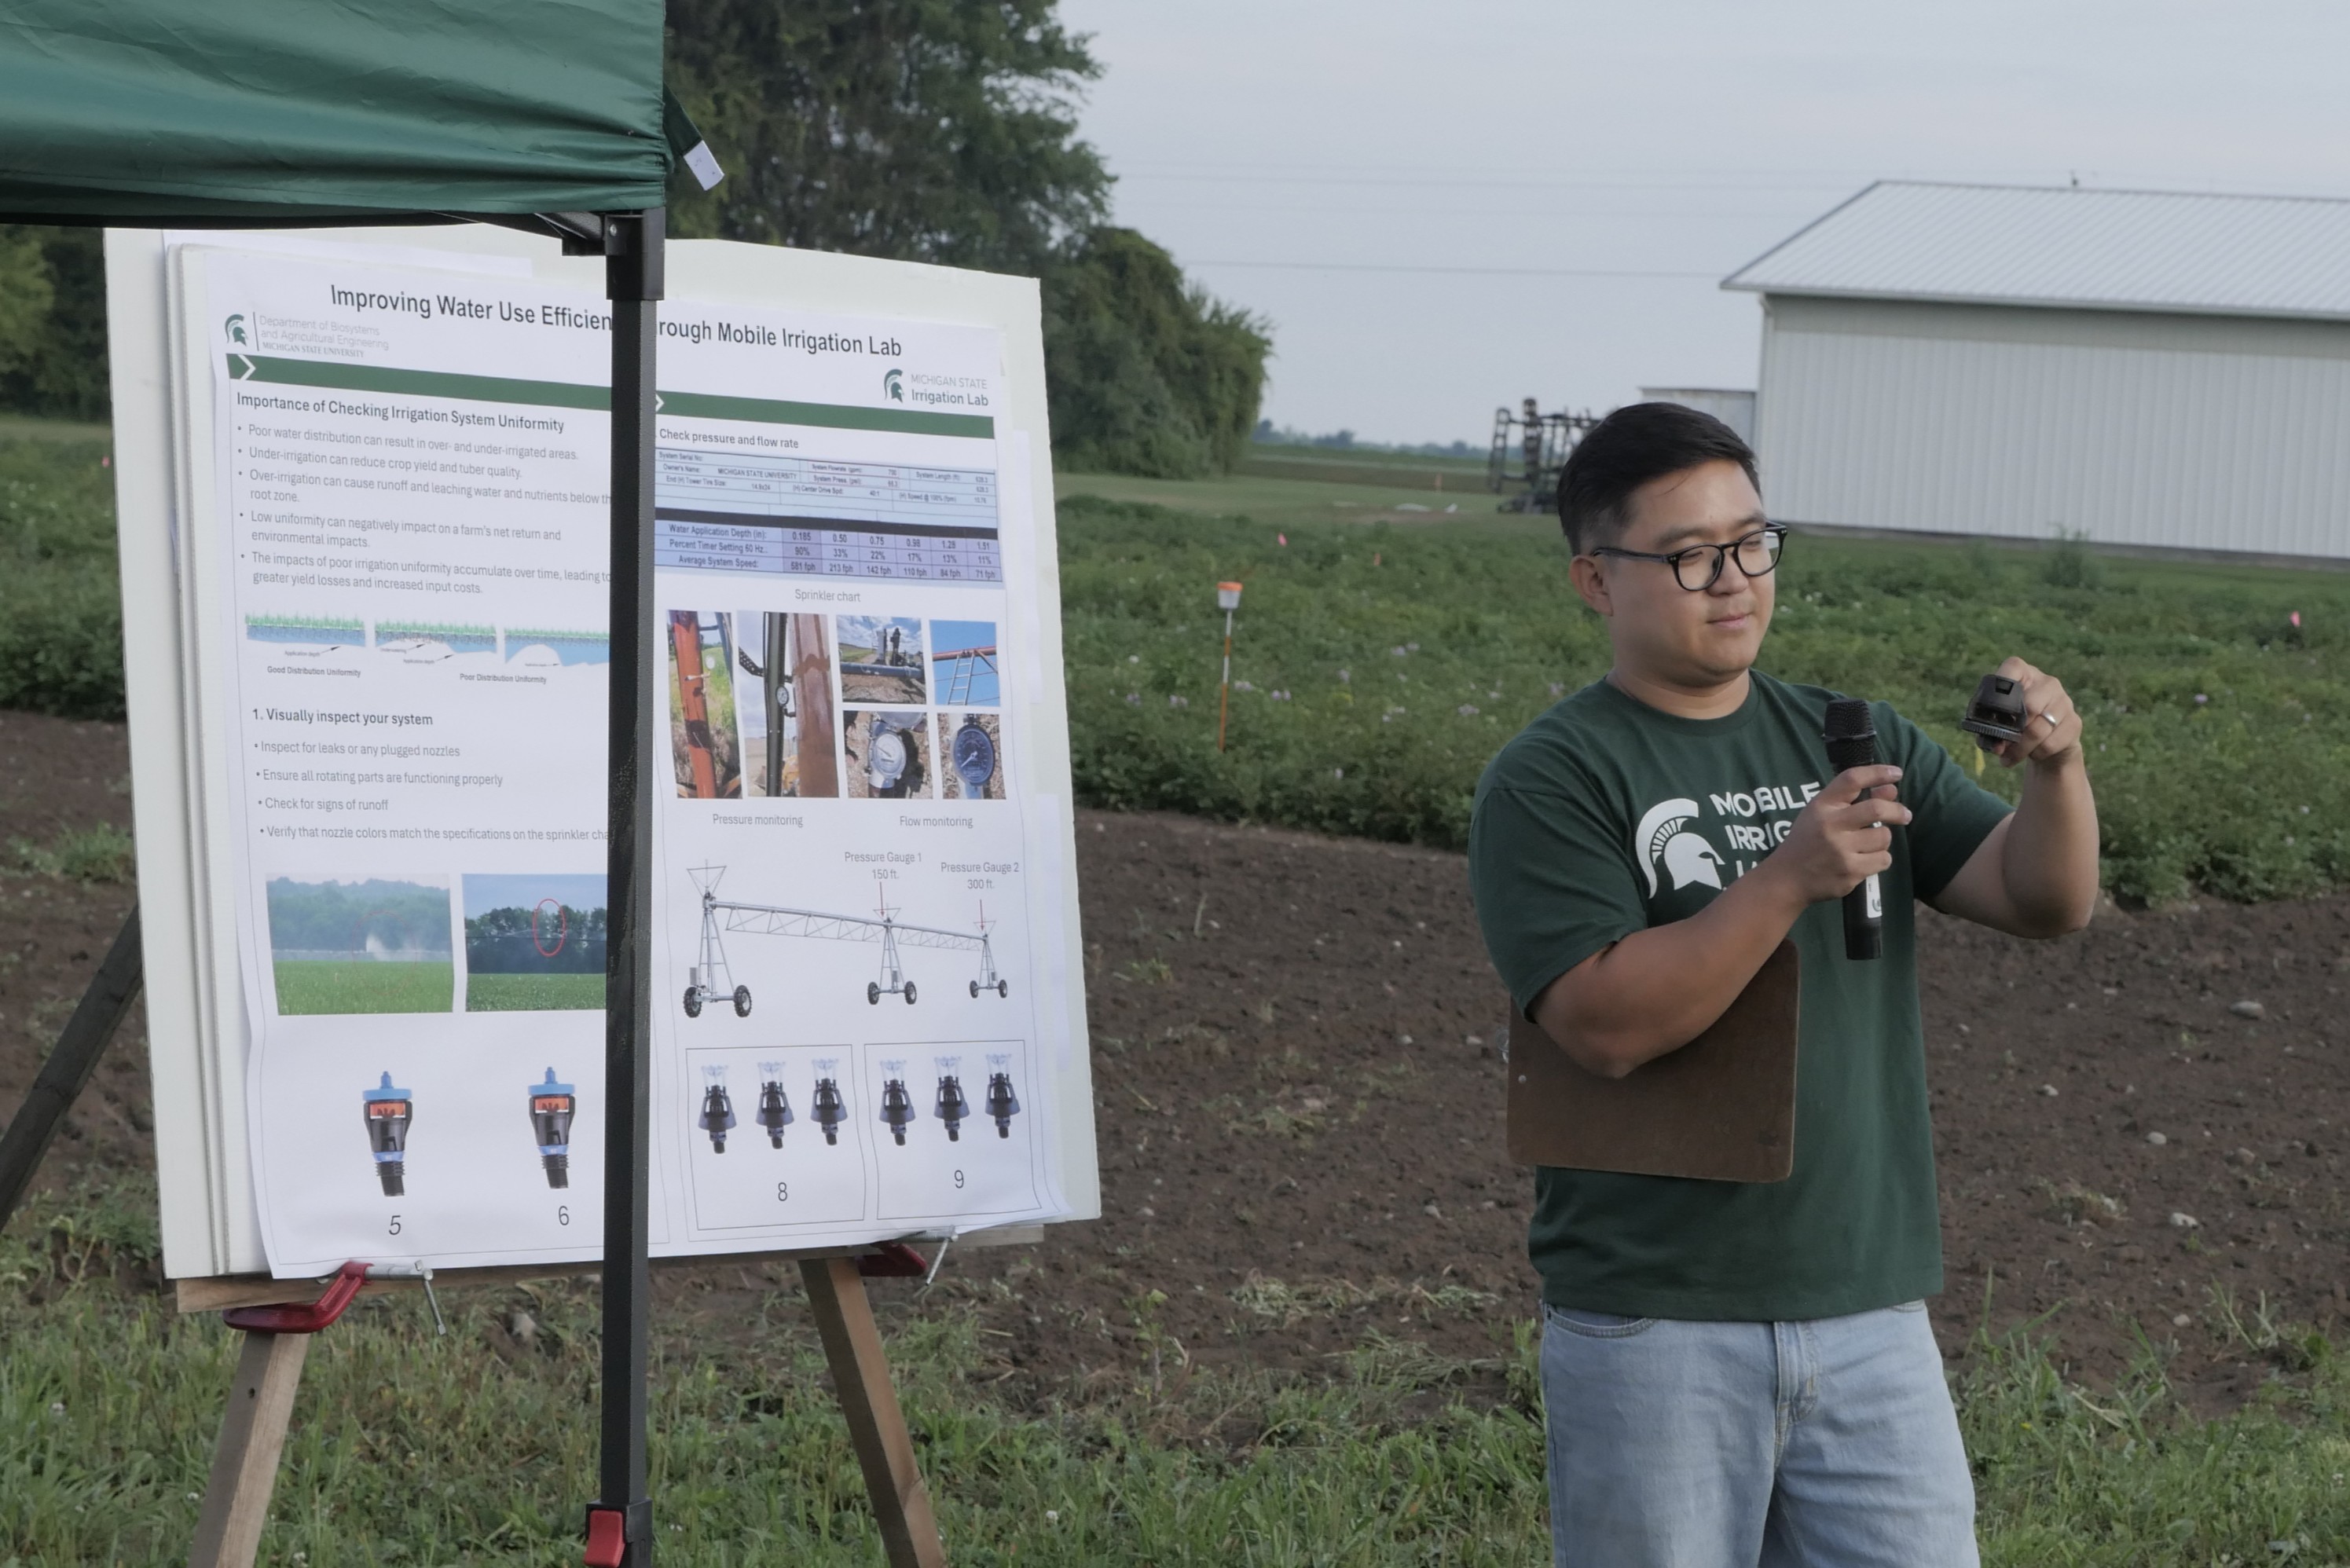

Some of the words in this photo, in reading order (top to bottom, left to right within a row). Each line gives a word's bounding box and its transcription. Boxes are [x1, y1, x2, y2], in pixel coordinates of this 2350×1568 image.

[330, 284, 431, 319] Improving
[436, 295, 493, 319] Water
[499, 301, 535, 323] Use
[541, 305, 613, 330] Efficien
[658, 321, 712, 344] rough
[717, 322, 776, 346] Mobile
[782, 328, 863, 354] Irrigation
[868, 335, 901, 356] Lab
[911, 374, 957, 387] MICHIGAN
[958, 377, 988, 390] STATE
[911, 389, 964, 405] Irrigation
[966, 393, 988, 406] Lab
[236, 392, 310, 411] Importance
[313, 400, 326, 412] of
[328, 401, 389, 421] Checking
[391, 405, 448, 423] Irrigation
[451, 410, 495, 427] System
[498, 415, 564, 434] Uniformity
[248, 423, 272, 437] Poor
[273, 428, 302, 439] water
[303, 429, 361, 444] distribution
[363, 435, 383, 445] can
[384, 437, 415, 448] result
[416, 437, 426, 449] in
[453, 441, 472, 452] and
[473, 444, 546, 459] under-irrigated
[548, 449, 578, 460] areas.
[659, 429, 690, 441] Check
[691, 433, 735, 444] pressure
[737, 435, 755, 445] and
[757, 435, 779, 447] flow
[779, 439, 798, 449] rate
[249, 446, 327, 464] Under-irrigation
[328, 455, 348, 465] can
[350, 456, 386, 468] reduce
[387, 460, 412, 471] crop
[413, 460, 438, 472] yield
[438, 462, 457, 473] and
[459, 463, 486, 475] tuber
[486, 466, 522, 480] quality.
[249, 468, 321, 486] Over-irrigation
[323, 477, 342, 486] can
[343, 478, 375, 489] cause
[376, 479, 409, 491] runoff
[409, 482, 430, 493] and
[431, 482, 473, 498] leaching
[473, 487, 502, 497] water
[504, 488, 522, 499] and
[524, 490, 568, 502] nutrients
[570, 492, 600, 504] below
[250, 489, 272, 500] root
[273, 491, 299, 502] zone.
[251, 510, 273, 522] Low
[274, 512, 325, 528] uniformity
[326, 518, 346, 527] can
[347, 519, 399, 533] negatively
[401, 522, 437, 534] impact
[438, 525, 451, 533] on
[452, 526, 459, 535] a
[493, 528, 510, 537] net
[511, 529, 541, 539] return
[542, 529, 561, 540] and
[669, 524, 689, 534] Water
[691, 526, 730, 536] Application
[731, 529, 751, 539] Depth
[753, 529, 767, 540] (in):
[792, 532, 811, 541] 0.185
[251, 531, 324, 544] environmental
[326, 533, 370, 548] impacts.
[251, 551, 271, 564] The
[273, 552, 314, 567] impacts
[316, 555, 327, 567] of
[328, 558, 353, 570] poor
[354, 558, 399, 572] irrigation
[401, 561, 452, 576] uniformity
[453, 566, 512, 577] accumulate
[514, 569, 536, 578] over
[537, 568, 563, 581] time,
[563, 569, 601, 584] leading
[252, 572, 289, 584] greater
[291, 573, 316, 586] yield
[317, 573, 351, 587] losses
[352, 577, 372, 588] and
[374, 577, 423, 590] increased
[425, 580, 452, 594] input
[453, 583, 482, 593] costs.
[794, 588, 835, 602] Sprinkler
[836, 591, 861, 603] chart
[267, 665, 286, 674] Good
[286, 666, 325, 675] Distribution
[326, 668, 361, 678] Uniformity
[476, 673, 514, 682] Distribution
[514, 675, 547, 685] Uniformity
[252, 708, 263, 720] 1.
[266, 708, 314, 724] Visually
[316, 710, 361, 725] inspect
[362, 714, 389, 726] your
[391, 714, 433, 727] system
[261, 740, 300, 754] Inspect
[301, 741, 317, 753] for
[318, 742, 346, 754] leaks
[347, 745, 358, 754] or
[360, 745, 379, 757] any
[379, 744, 420, 758] plugged
[422, 746, 460, 757] nozzles
[262, 768, 299, 781] Ensure
[300, 769, 314, 781] all
[315, 771, 357, 785] rotating
[357, 772, 384, 785] parts
[386, 774, 402, 783] are
[403, 771, 460, 787] functioning
[462, 774, 503, 787] properly
[265, 797, 299, 809] Check
[299, 797, 314, 809] for
[317, 800, 344, 812] signs
[345, 798, 356, 810] of
[357, 799, 389, 811] runoff
[1709, 781, 1820, 817] MOBILE
[712, 813, 753, 825] Pressure
[754, 815, 804, 828] monitoring
[899, 815, 921, 826] Flow
[922, 815, 973, 829] monitoring
[267, 826, 296, 840] Verify
[298, 826, 320, 837] that
[321, 826, 354, 838] nozzle
[355, 826, 388, 838] colors
[389, 827, 422, 838] match
[423, 827, 441, 839] the
[442, 828, 511, 841] specifications
[512, 830, 526, 840] on
[526, 829, 544, 840] the
[545, 829, 589, 842] sprinkler
[1724, 820, 1792, 851] IRRIG
[844, 851, 885, 863] Pressure
[886, 851, 915, 865] Gauge
[917, 852, 922, 863] 1
[871, 868, 889, 878] 150
[940, 862, 981, 873] Pressure
[982, 861, 1012, 874] Gauge
[1013, 861, 1019, 872] 2
[967, 878, 984, 889] 300
[954, 1170, 964, 1189] 9
[778, 1182, 788, 1202] 8
[558, 1205, 570, 1225] 6
[388, 1214, 401, 1236] 5
